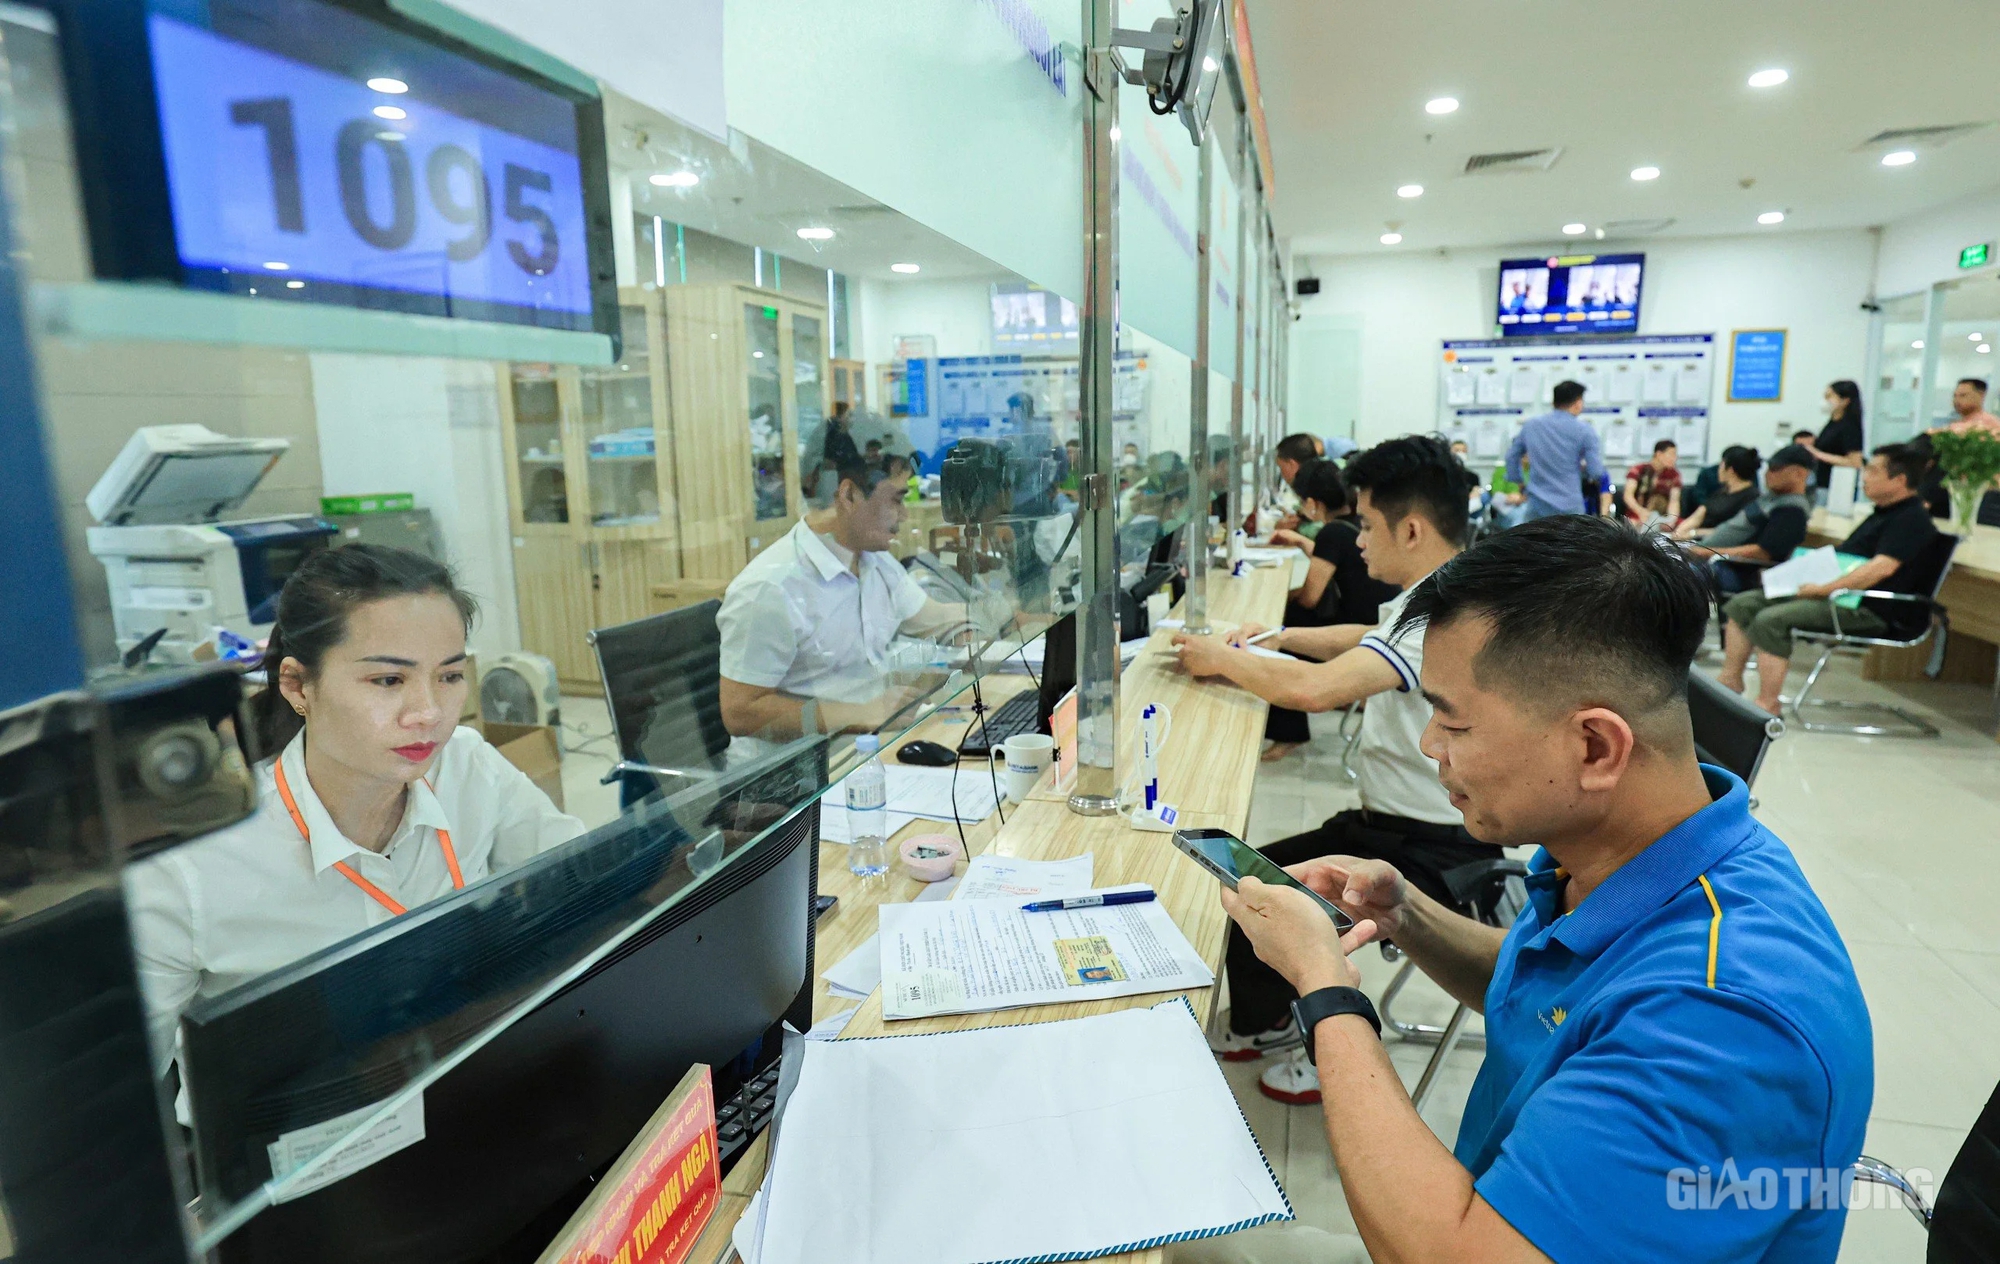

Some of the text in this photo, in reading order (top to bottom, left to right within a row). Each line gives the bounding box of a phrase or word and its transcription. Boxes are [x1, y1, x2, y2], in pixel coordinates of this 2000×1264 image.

[229, 96, 561, 277] 1095
[1537, 1008, 1556, 1036] Vietna
[633, 1170, 682, 1261] THANH
